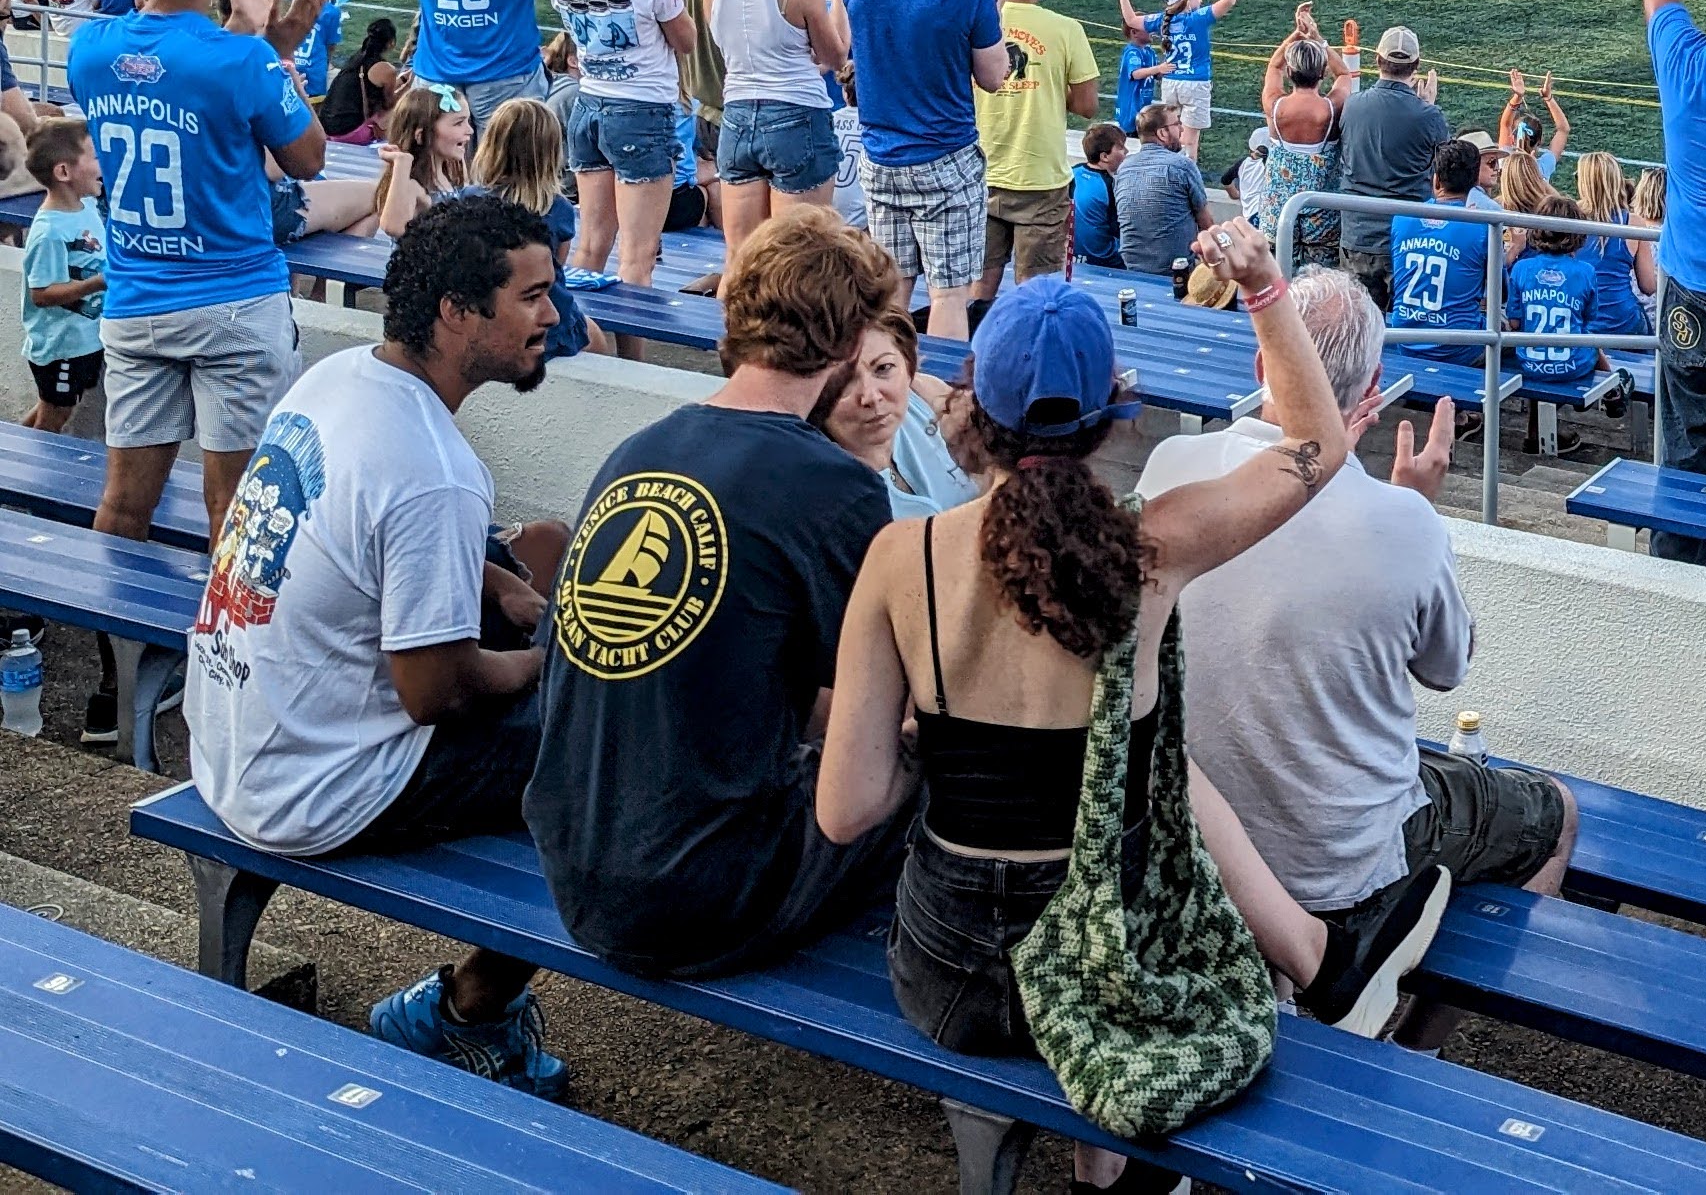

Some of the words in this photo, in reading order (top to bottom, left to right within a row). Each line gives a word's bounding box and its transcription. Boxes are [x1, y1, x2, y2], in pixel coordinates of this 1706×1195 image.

[433, 12, 499, 28] SIXGEN
[1007, 28, 1047, 55] MOVES
[1008, 80, 1040, 90] SLEEP
[87, 93, 199, 135] ANNAPOLIS
[100, 121, 187, 229] 23
[111, 225, 204, 256] SIXGEN
[1399, 237, 1461, 261] ANNAPOLIS
[1402, 252, 1448, 312] 23
[1521, 288, 1581, 311] ANNAPOLIS
[1398, 306, 1447, 324] SIXGEN
[574, 486, 629, 551] VENICE
[634, 482, 697, 511] BEACH
[689, 508, 717, 571] CALIF
[587, 641, 649, 667] YACHT
[654, 596, 705, 650] CLUB
